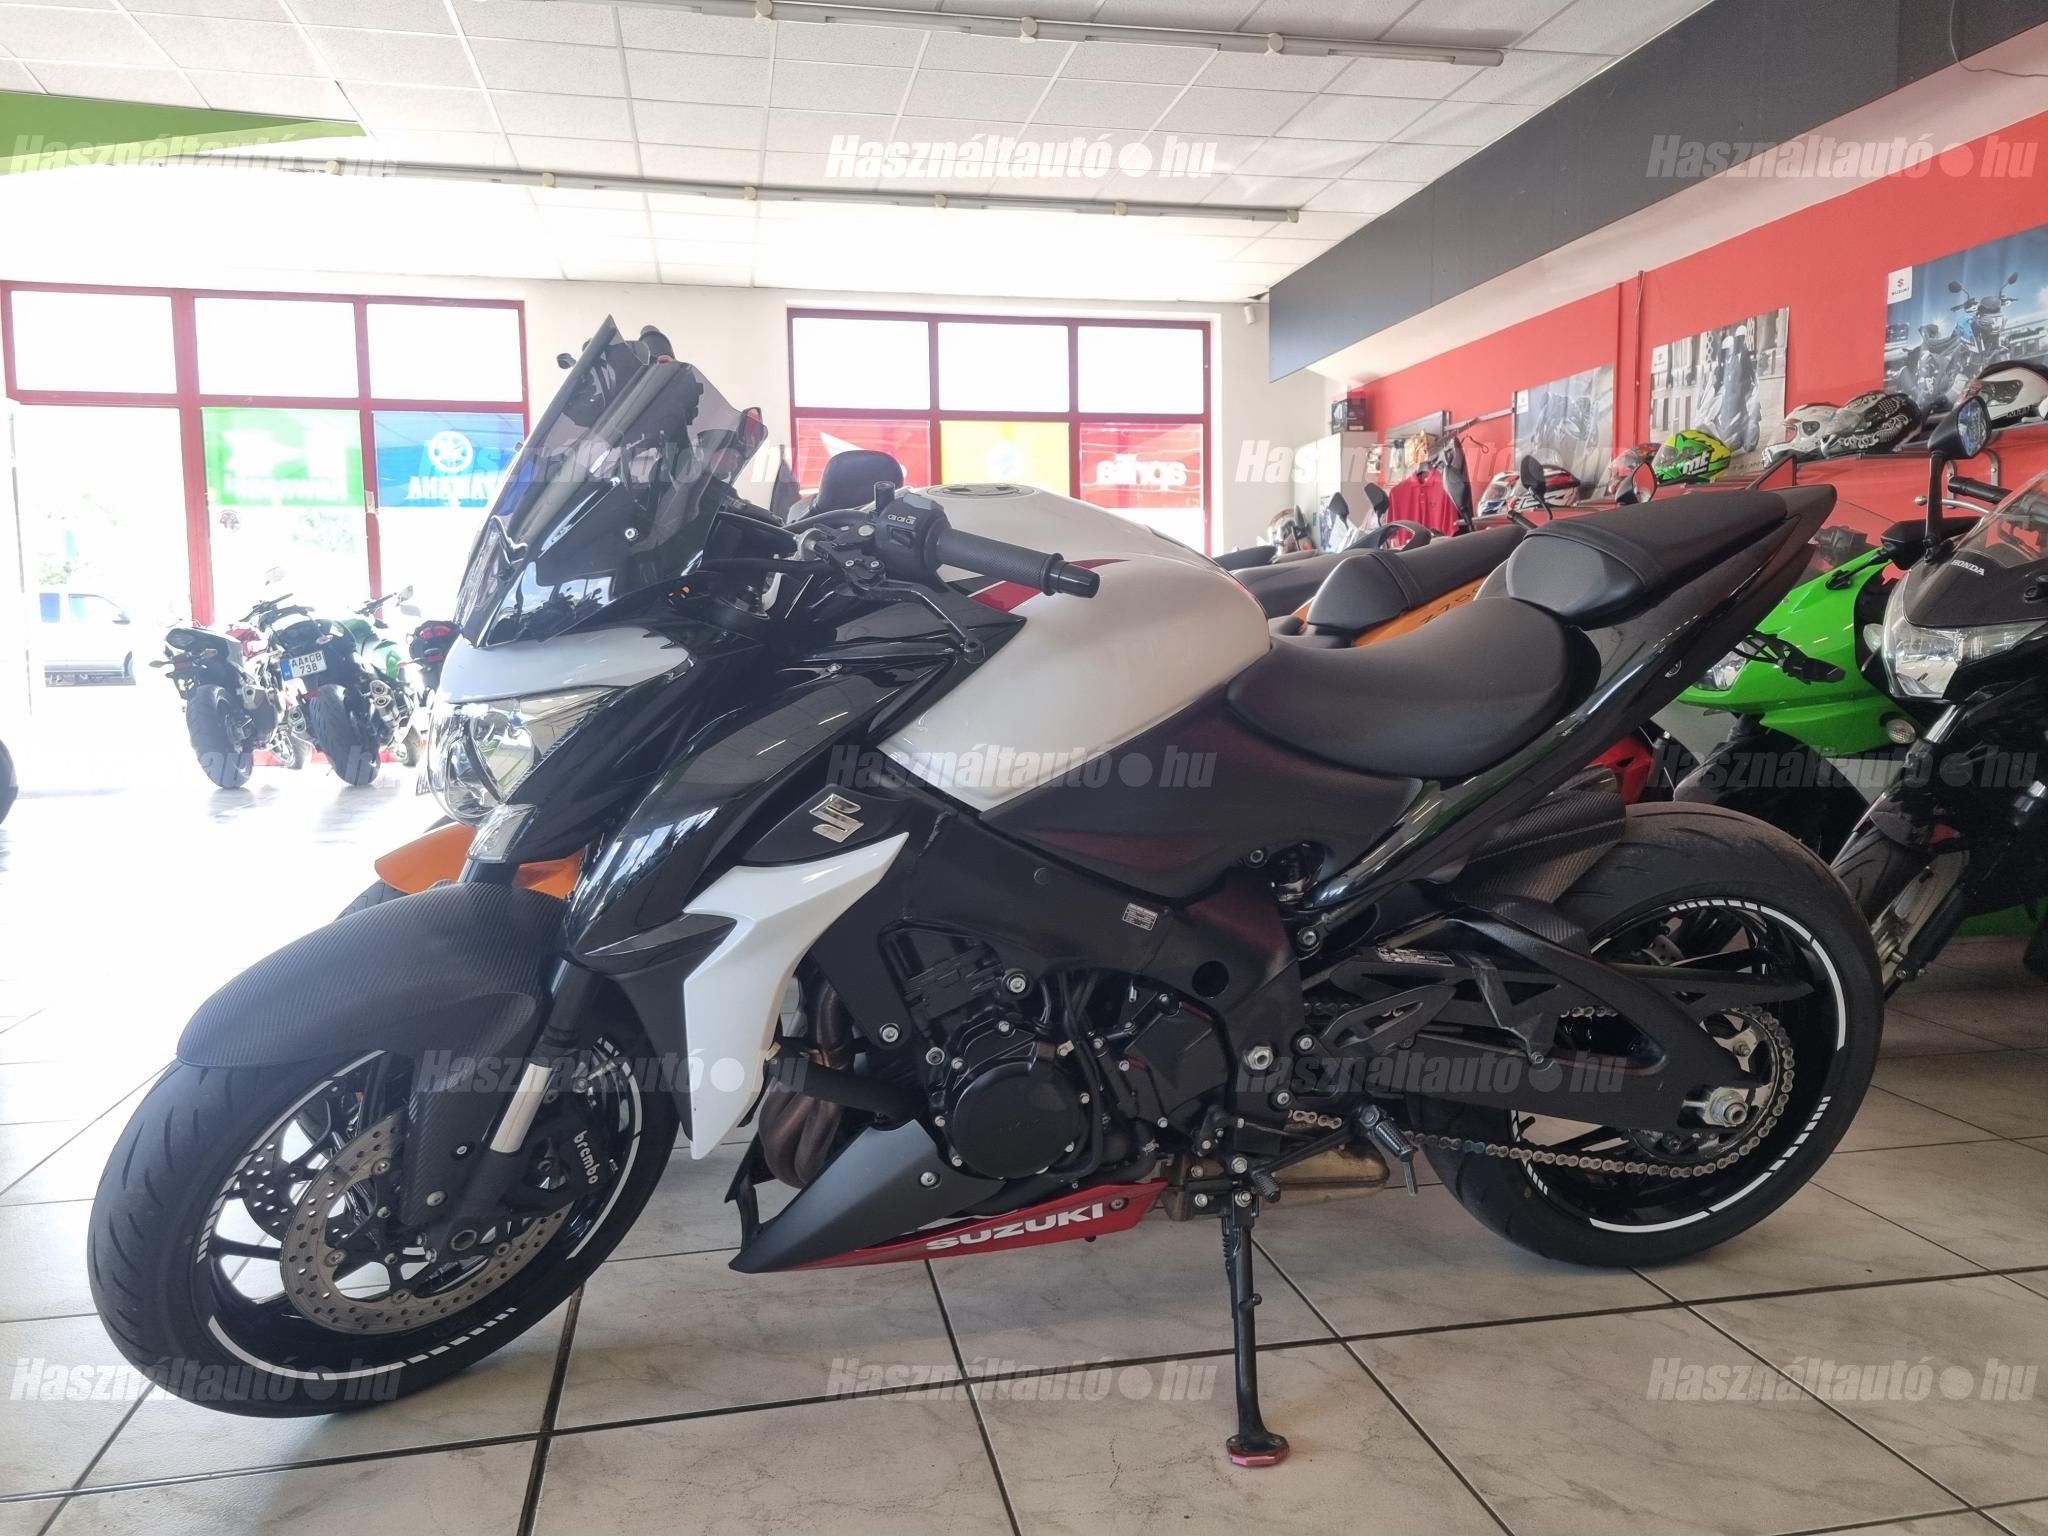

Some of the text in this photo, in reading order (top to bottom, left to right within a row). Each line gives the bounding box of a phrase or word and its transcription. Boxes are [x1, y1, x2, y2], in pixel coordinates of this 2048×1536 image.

[1951, 559, 1985, 576] HONDA
[573, 1129, 601, 1185] brembo
[926, 1203, 1104, 1250] SUZUKI
